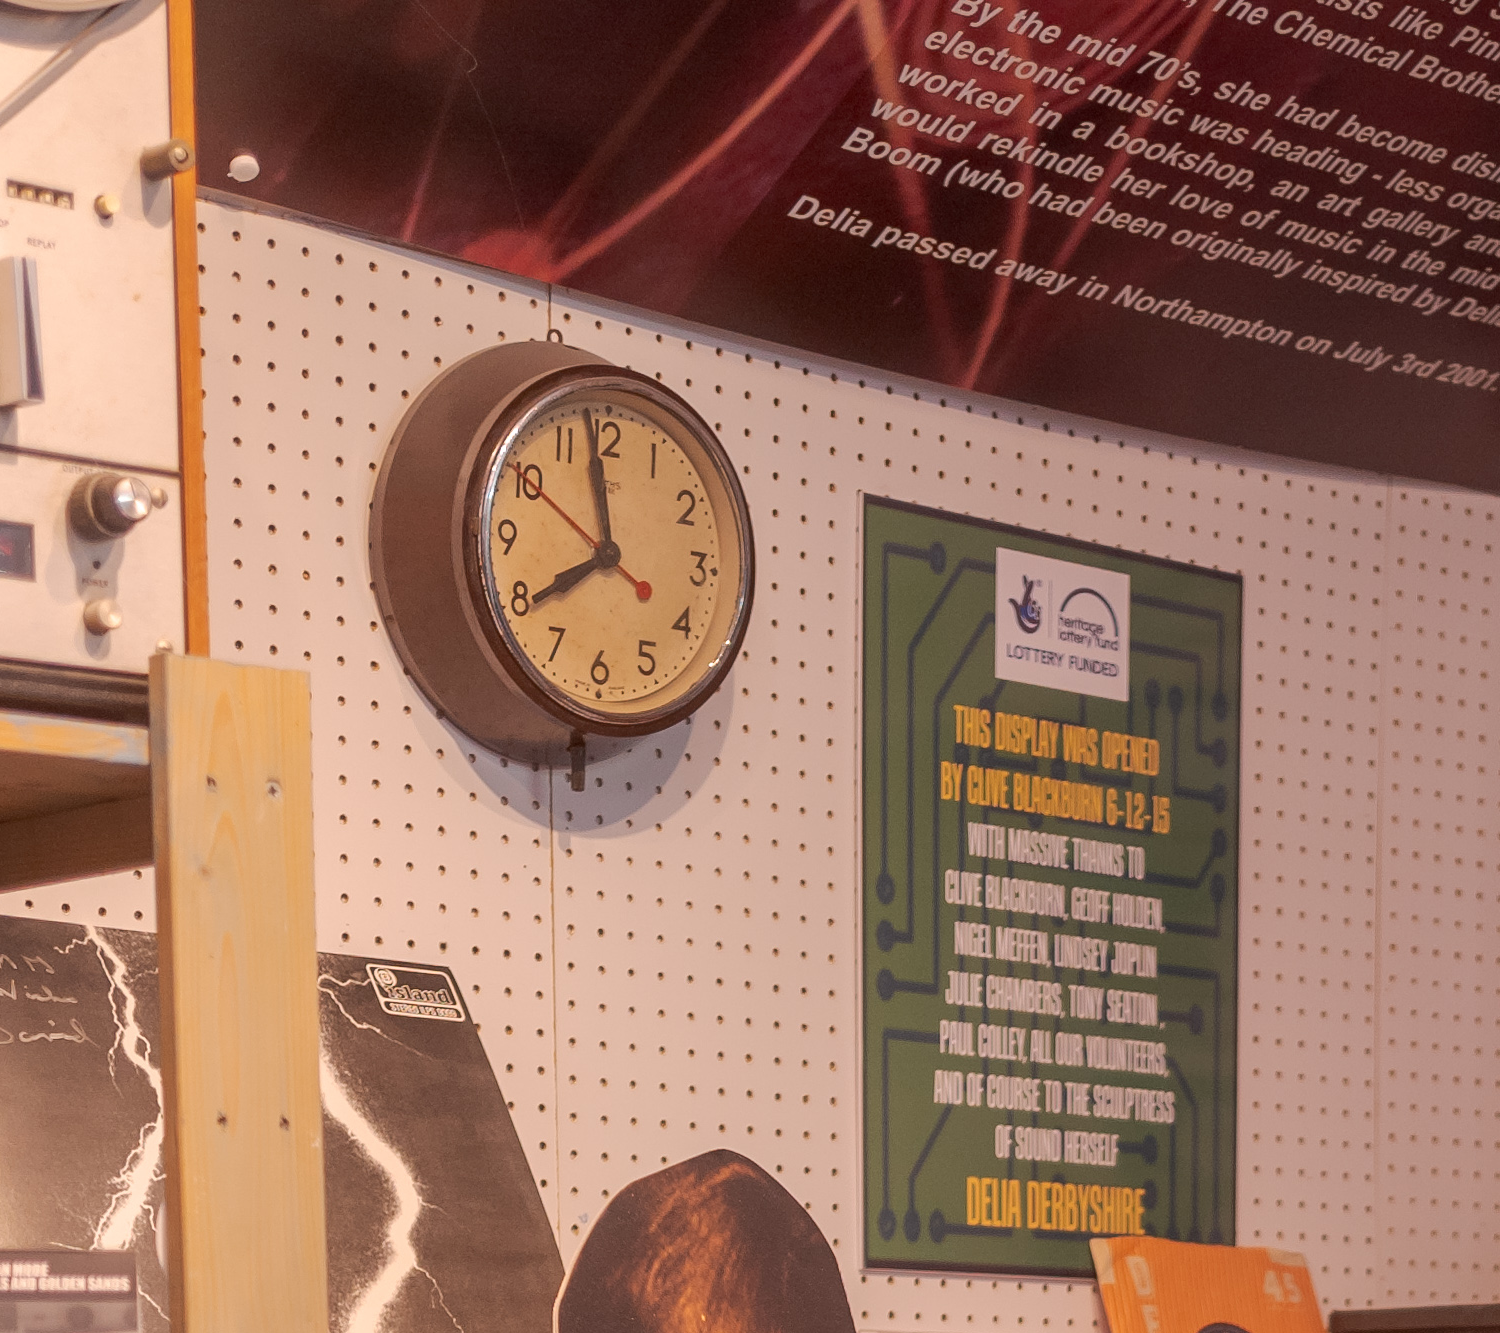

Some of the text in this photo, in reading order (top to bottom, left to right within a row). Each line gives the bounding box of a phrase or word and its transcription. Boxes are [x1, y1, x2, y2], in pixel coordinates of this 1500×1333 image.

[950, 0, 1004, 28] By
[1006, 9, 1062, 44] the
[1066, 33, 1137, 68] mid
[1136, 50, 1202, 96] 70's,
[1213, 81, 1272, 111] she
[1274, 95, 1340, 131] had
[1336, 114, 1448, 164] become
[787, 195, 1500, 391] Delia passed away in Northampton on July 3rd 2001.
[556, 424, 575, 464] 11
[516, 461, 543, 501] 10
[676, 489, 697, 526] 2
[498, 519, 517, 555] 9
[689, 550, 708, 587] 3
[511, 580, 529, 616] 8
[671, 605, 693, 640] 4
[547, 626, 567, 662] 7
[637, 639, 657, 676] 5
[1008, 645, 1118, 678] LOTTERY FUNDED
[590, 650, 610, 685] 6
[386, 985, 453, 1005] island
[1262, 1269, 1302, 1305] 45
